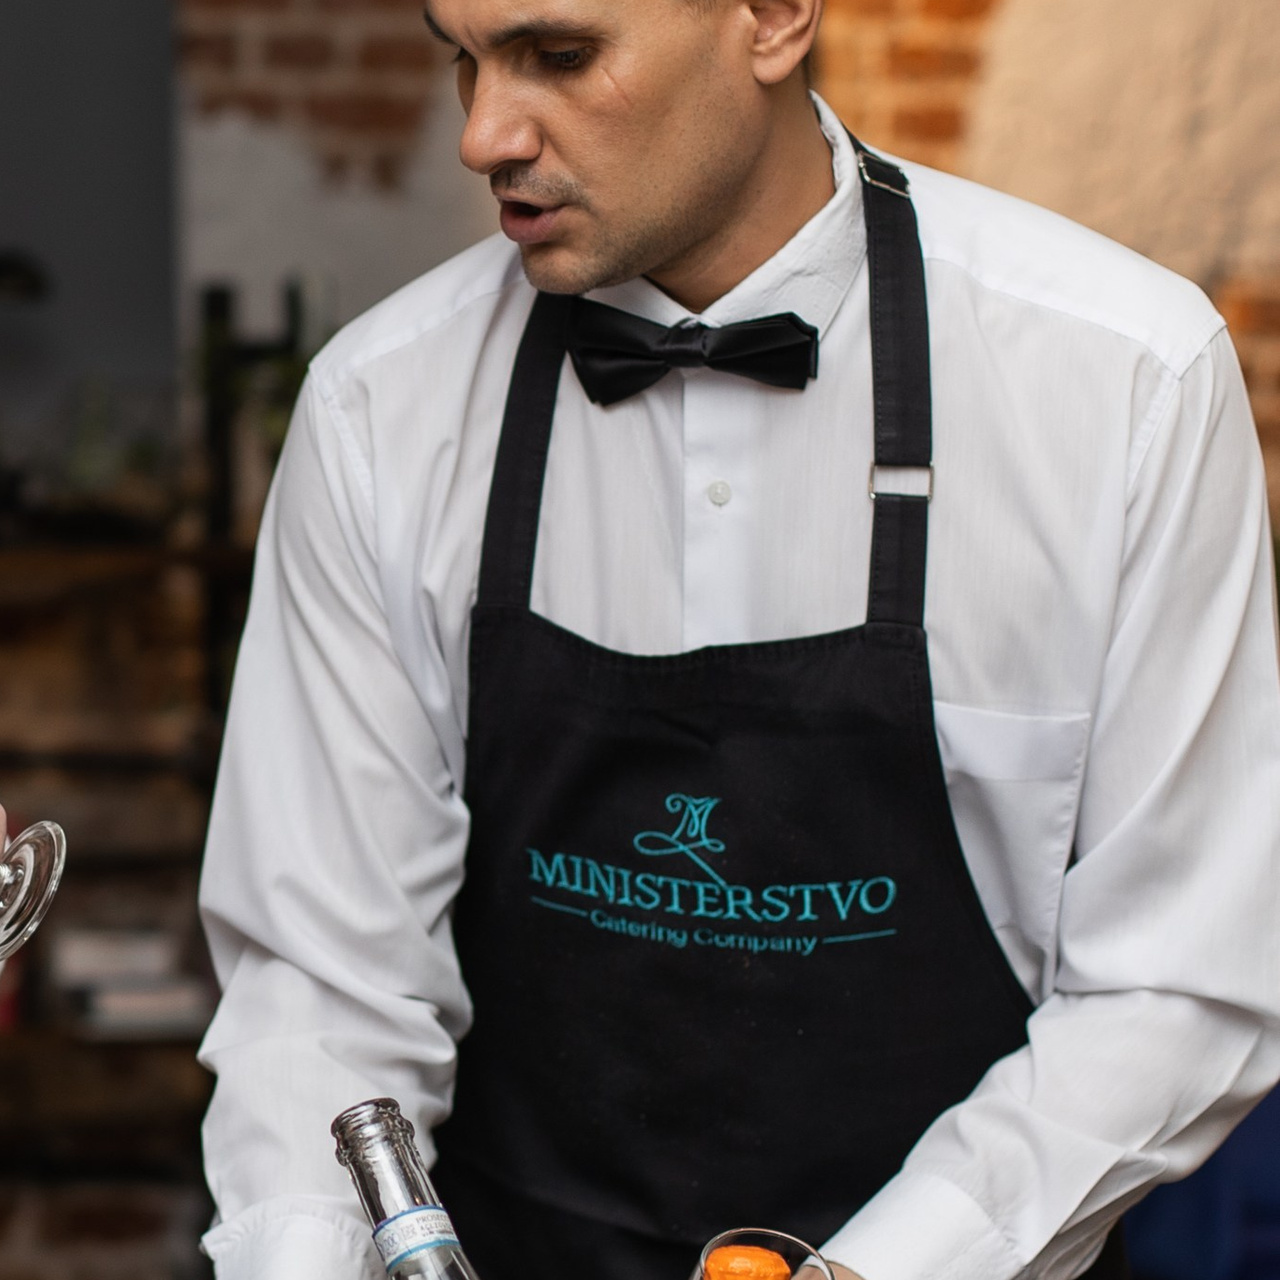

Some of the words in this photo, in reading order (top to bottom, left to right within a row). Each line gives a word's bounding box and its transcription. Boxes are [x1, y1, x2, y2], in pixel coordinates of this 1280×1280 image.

[526, 848, 898, 922] MINISTERSTVO
[590, 909, 688, 949] Catering
[693, 926, 818, 956] Company
